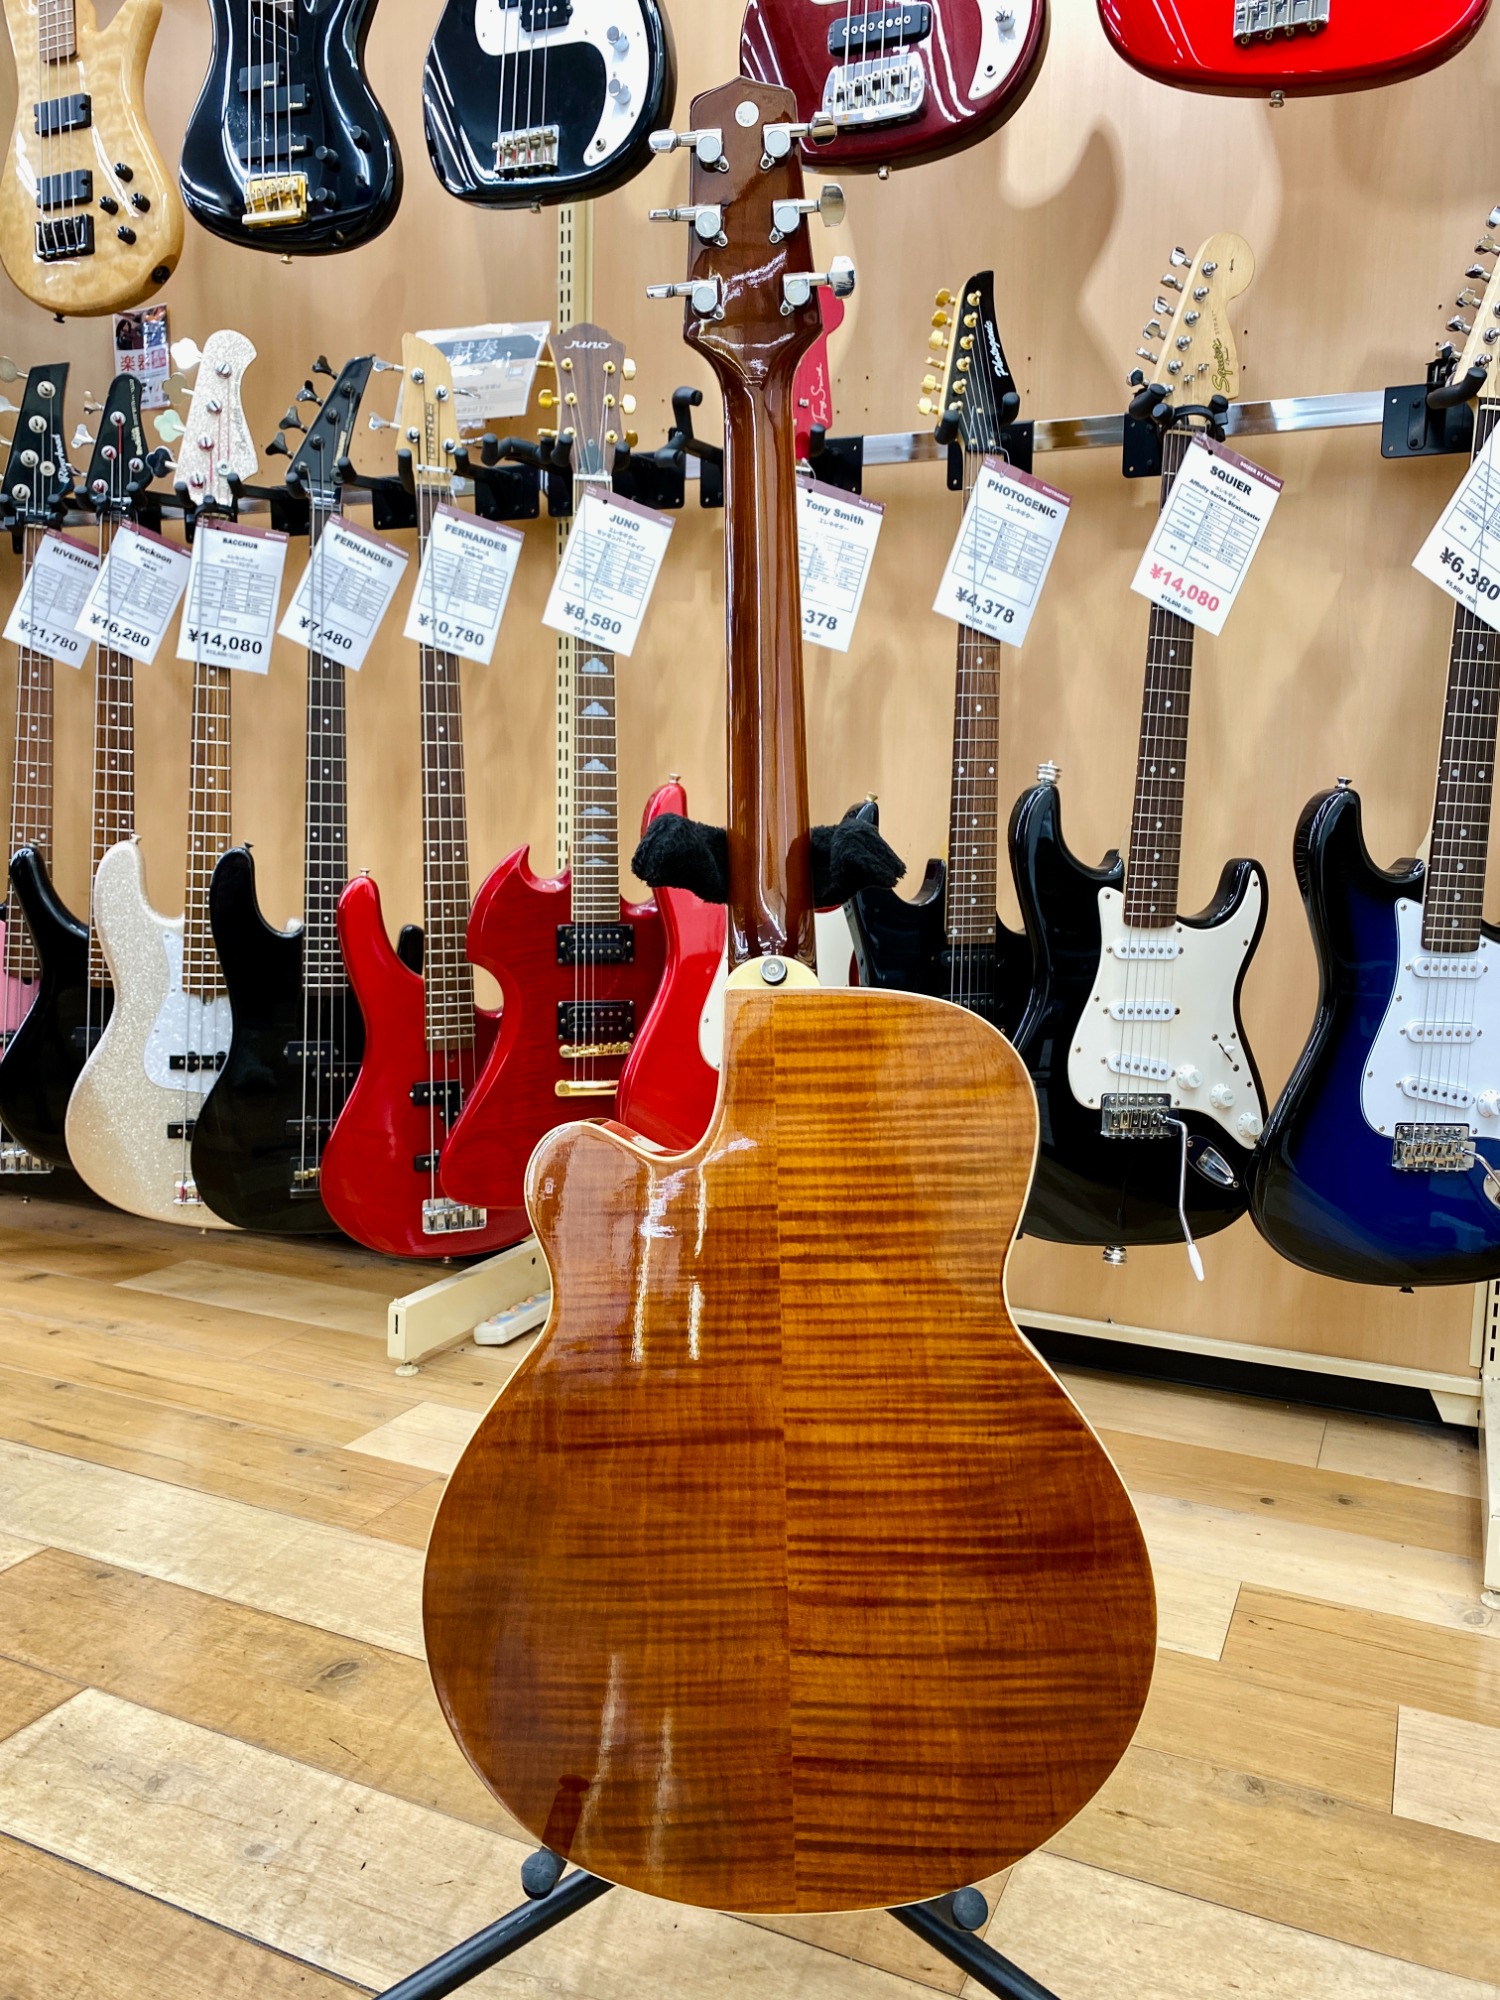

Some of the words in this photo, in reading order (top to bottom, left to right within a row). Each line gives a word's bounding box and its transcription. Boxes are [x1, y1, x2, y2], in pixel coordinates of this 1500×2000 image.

[1212, 337, 1233, 393] Squier
[1209, 464, 1253, 495] SQUIER
[804, 498, 831, 516] Tony
[833, 507, 864, 525] Smith
[986, 478, 1058, 518] PHOTOGENIC
[444, 523, 508, 552] FERNANDES
[608, 513, 640, 532] JUNO
[52, 546, 100, 571] RIVERHEA
[135, 542, 172, 564] rockoon
[222, 537, 258, 549] BACCHUS
[333, 533, 394, 568] FERNANDES
[1148, 562, 1221, 612] ¥14,080
[1438, 546, 1500, 602] ¥6,380
[562, 601, 623, 635] ¥8,580
[954, 586, 1016, 624] ¥4,378
[17, 618, 78, 652] ¥21,780
[88, 612, 151, 647] ¥16,280
[187, 628, 262, 654] ¥14,080
[298, 616, 353, 650] ¥7,480
[416, 613, 485, 646] ¥10,780
